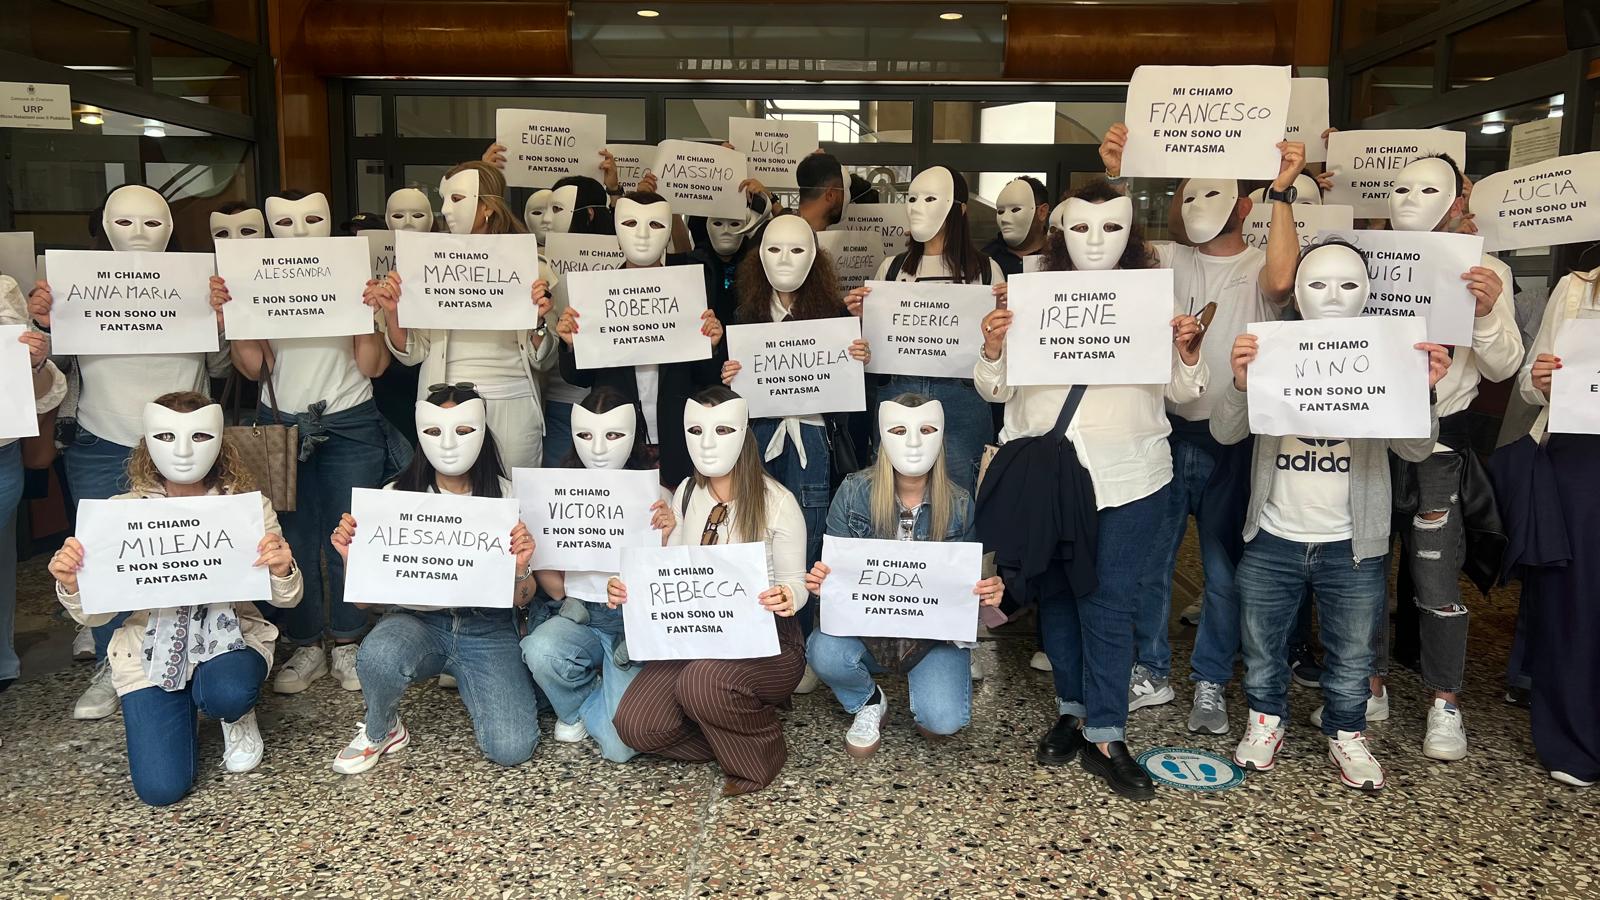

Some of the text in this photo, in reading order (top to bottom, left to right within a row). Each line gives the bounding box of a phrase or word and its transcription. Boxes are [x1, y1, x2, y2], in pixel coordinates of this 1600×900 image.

[1189, 88, 1233, 96] CHIAMO
[1149, 102, 1271, 125] FRANCESCO
[540, 125, 570, 133] CHIAMO
[1191, 130, 1222, 138] SONO
[1225, 130, 1241, 138] UN
[522, 132, 575, 147] EUGENIO
[751, 139, 788, 156] LUIGI
[1165, 144, 1225, 153] FANTASMA
[686, 156, 715, 164] CHIAMO
[661, 163, 733, 181] MASSIMO
[1529, 169, 1572, 182] CHIAMO
[675, 192, 713, 200] FANTASMA
[1502, 179, 1578, 203] LUCIA
[1509, 201, 1586, 216] NON SONO UN
[1513, 215, 1573, 228] FANTASMA
[278, 257, 319, 265] CHIAMO
[1377, 252, 1421, 260] CHIAMO
[551, 260, 588, 274] MARIA
[254, 266, 331, 281] ALESSANDRA
[424, 264, 521, 284] MARIELLA
[1370, 265, 1412, 282] UIGI
[623, 286, 661, 295] CHIAMO
[263, 296, 286, 304] NON
[289, 294, 318, 303] SONO
[1054, 292, 1116, 302] MI CHIAMO
[1381, 293, 1411, 302] SONO
[1415, 296, 1431, 304] UN
[605, 297, 679, 318] ROBERTA
[913, 301, 950, 309] CHIAMO
[268, 308, 325, 316] FANTASMA
[1040, 304, 1116, 330] IRENE
[1362, 307, 1416, 317] ANTASMA
[893, 313, 958, 327] FEDERICA
[632, 323, 659, 331] SONO
[613, 335, 665, 345] FANTASMA
[779, 338, 816, 348] CHIAMO
[1078, 336, 1110, 345] SONO
[1299, 340, 1369, 351] MI CHIAMO
[898, 348, 947, 356] FANTASMA
[1054, 351, 1115, 359] FANTASMA
[754, 349, 849, 373] EMANUELA
[1295, 354, 1369, 379] NINO
[788, 374, 814, 382] SONO
[770, 386, 820, 396] FANTASMA
[1295, 386, 1385, 396] NON SONO UN
[1300, 402, 1369, 411] FANTASMA
[1276, 451, 1350, 472] adida
[569, 489, 610, 497] CHIAMO
[548, 502, 624, 520] VICTORIA
[400, 513, 462, 524] MI CHIAMO
[128, 519, 200, 530] MI CHIAMO
[578, 527, 606, 536] SONO
[119, 529, 234, 559] MILENA
[368, 526, 504, 555] ALESSANDRA
[557, 541, 611, 549] FANTASMA
[129, 558, 222, 571] NON SONO UN
[393, 555, 473, 567] NON SONO UN
[883, 560, 926, 570] CHIAMO
[396, 570, 458, 581] FANTASMA
[673, 567, 714, 576] CHIAMO
[136, 573, 208, 585] FANTASMA
[858, 570, 923, 589] EDDA
[649, 580, 747, 606] REBECCA
[862, 593, 885, 602] NON
[889, 595, 919, 604] SONO
[661, 610, 734, 620] NON SONO UN
[865, 607, 924, 616] FANTASMA
[667, 625, 723, 634] FANTASMA
